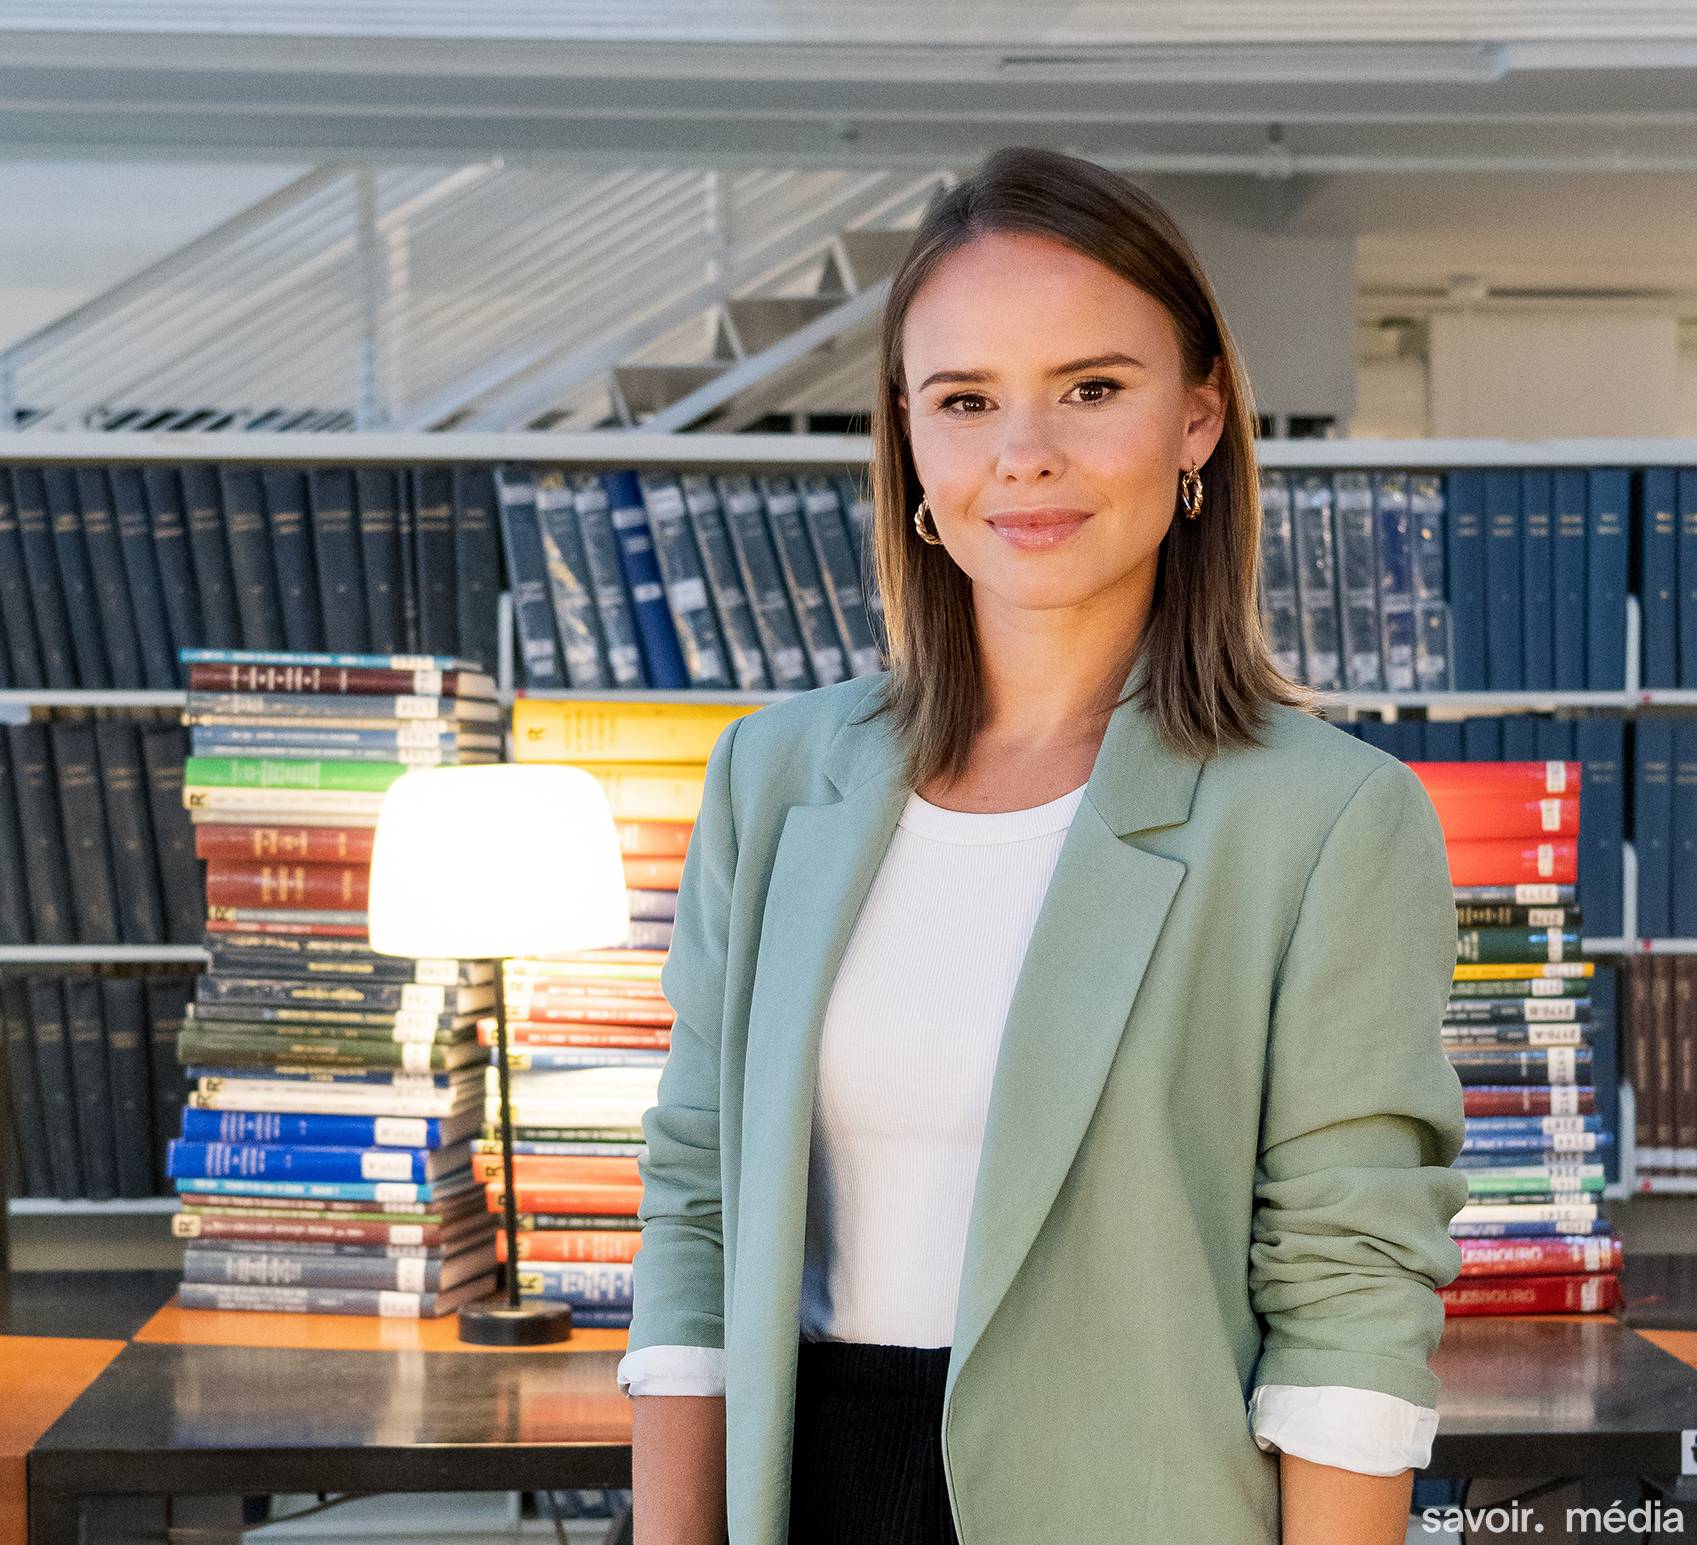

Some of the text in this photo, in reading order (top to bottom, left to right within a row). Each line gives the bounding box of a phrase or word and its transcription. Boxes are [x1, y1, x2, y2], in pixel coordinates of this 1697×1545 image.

[528, 727, 545, 740] R
[190, 793, 207, 806] R
[486, 1166, 502, 1177] R
[179, 1220, 194, 1233] R
